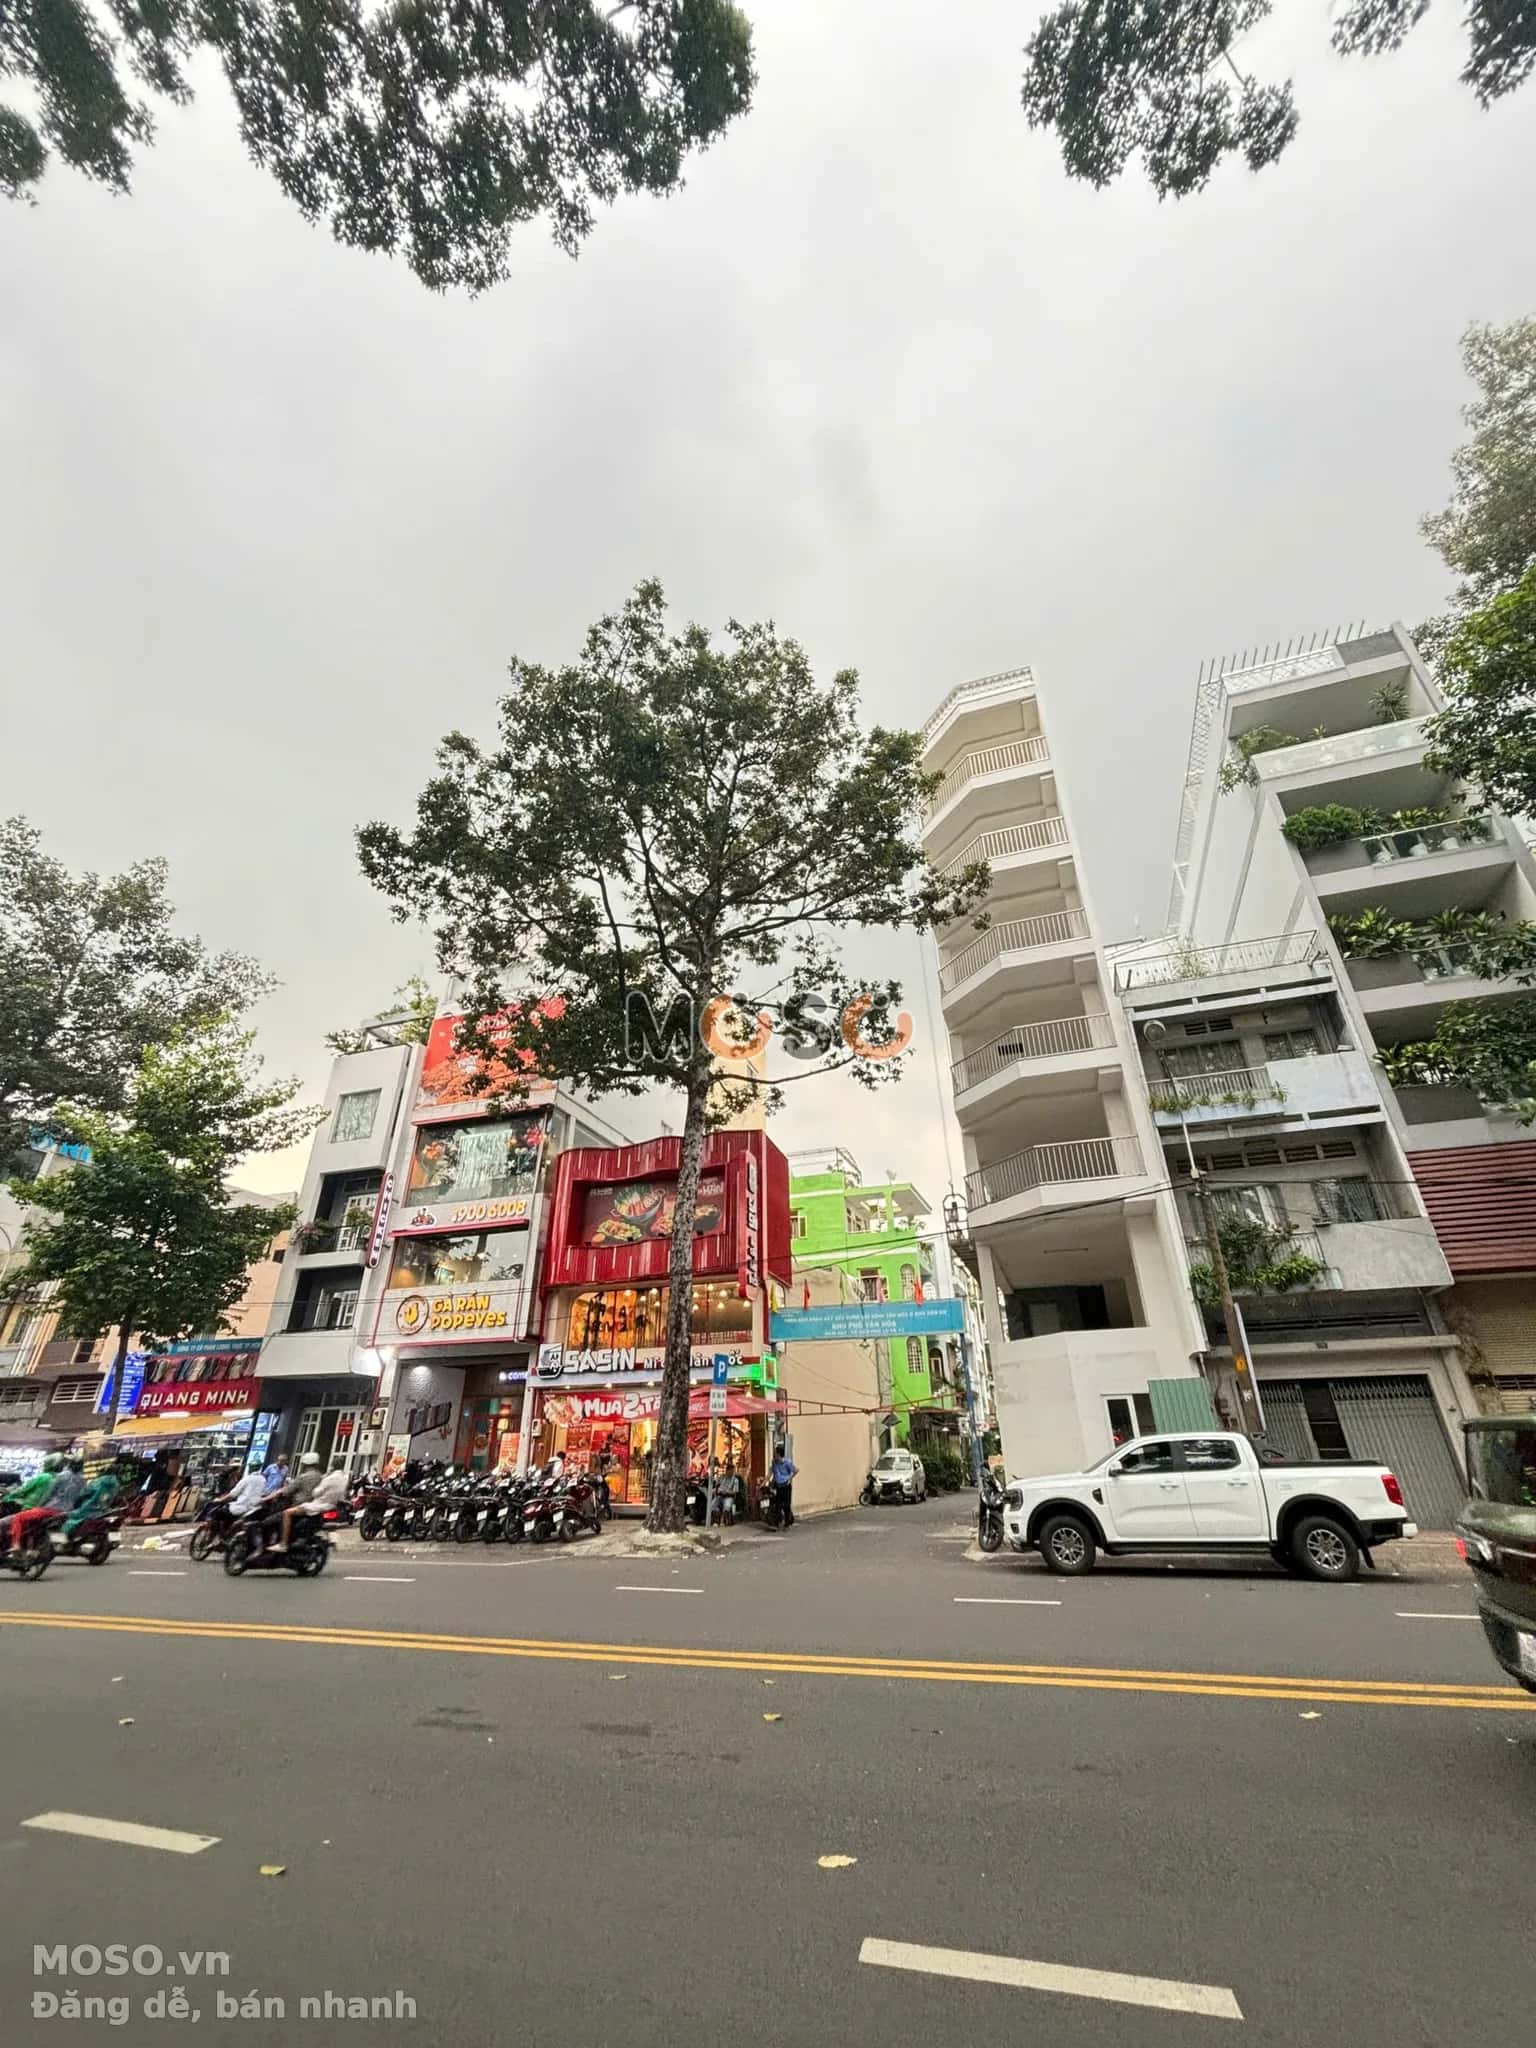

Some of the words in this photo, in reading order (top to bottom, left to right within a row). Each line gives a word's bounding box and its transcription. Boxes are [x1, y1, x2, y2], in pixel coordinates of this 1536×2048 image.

[453, 1205, 488, 1223] 1900
[487, 1200, 527, 1219] 6008
[432, 1292, 453, 1313] GÀ
[456, 1291, 490, 1312] RÁN
[564, 1348, 635, 1373] SASIN
[718, 1362, 727, 1378] P
[141, 1391, 201, 1409] QUANG
[205, 1389, 249, 1405] MINH
[585, 1398, 622, 1418] MUA
[623, 1392, 641, 1419] 2
